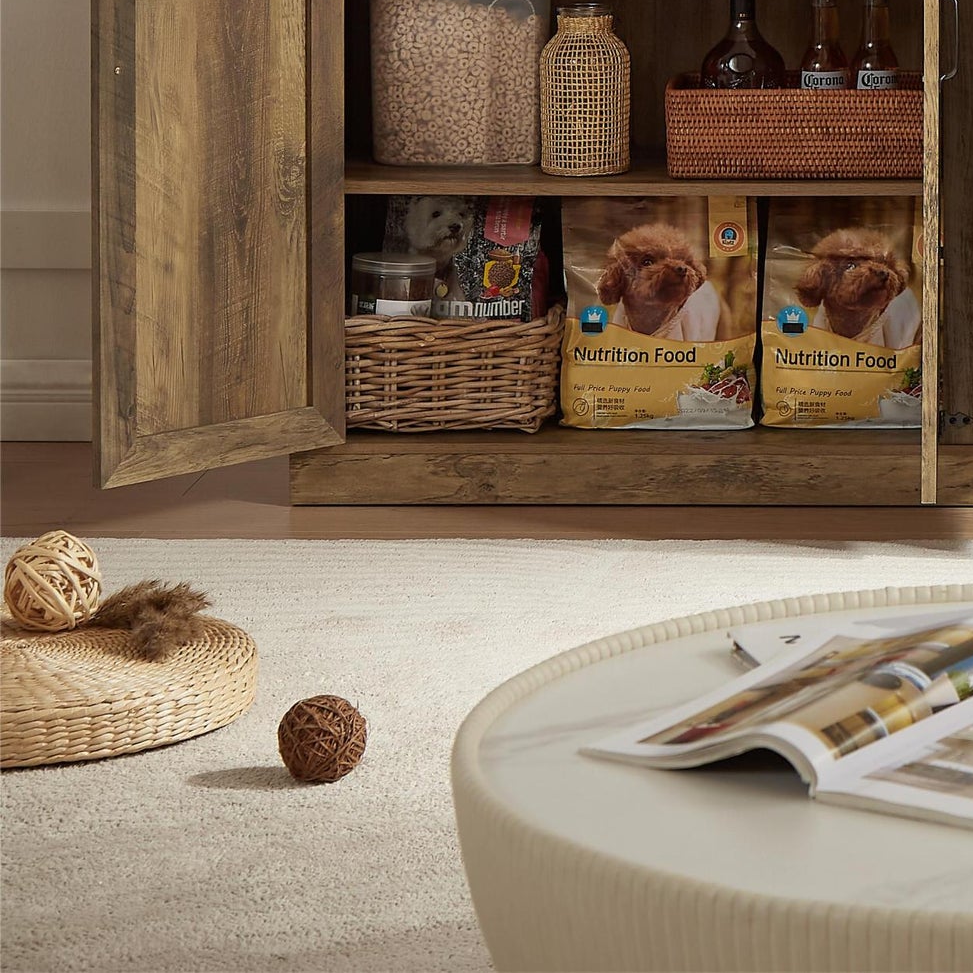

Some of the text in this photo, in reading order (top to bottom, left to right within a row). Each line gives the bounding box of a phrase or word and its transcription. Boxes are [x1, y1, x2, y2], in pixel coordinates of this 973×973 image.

[861, 72, 897, 87] Coron
[474, 298, 526, 317] number
[574, 346, 696, 363] Nutrition Food
[775, 348, 897, 369] Nutrition Food
[587, 384, 605, 392] Price
[608, 384, 631, 394] Puppy
[634, 385, 651, 393] Food
[776, 386, 853, 398] Full Price Puppy Food
